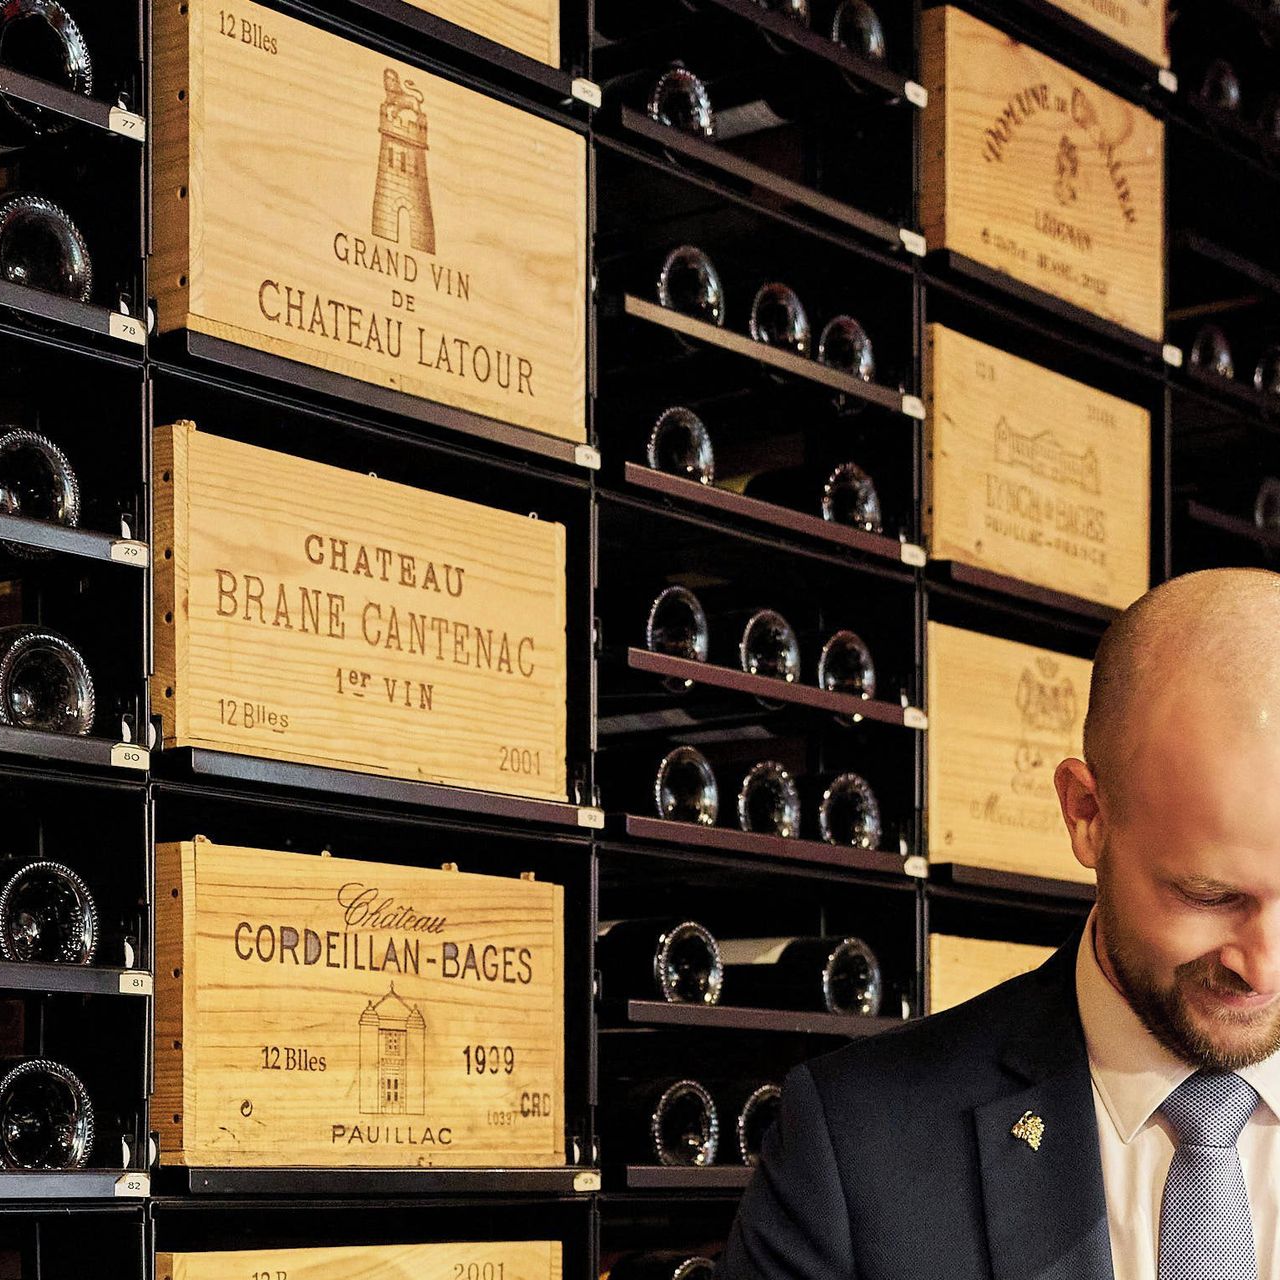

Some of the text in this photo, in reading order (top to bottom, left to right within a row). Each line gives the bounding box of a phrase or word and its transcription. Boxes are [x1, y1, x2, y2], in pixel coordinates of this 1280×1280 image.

[219, 10, 279, 55] 12 Blles
[334, 232, 470, 301] GRAND VIN
[392, 289, 416, 312] DE
[122, 324, 136, 336] 78
[258, 279, 535, 397] CHATEAU LATOUR
[304, 534, 465, 598] CHATEAU
[216, 569, 535, 678] BRANE CANTENAC
[336, 667, 434, 712] 1er VIN
[219, 699, 290, 734] 12 Blles
[124, 752, 140, 762] 80
[499, 746, 541, 777] 2001
[337, 882, 446, 934] Château
[132, 978, 144, 988] 81
[262, 1046, 327, 1072] 12 Blles
[331, 1125, 453, 1146] PAUILLAC
[128, 1181, 141, 1191] 82
